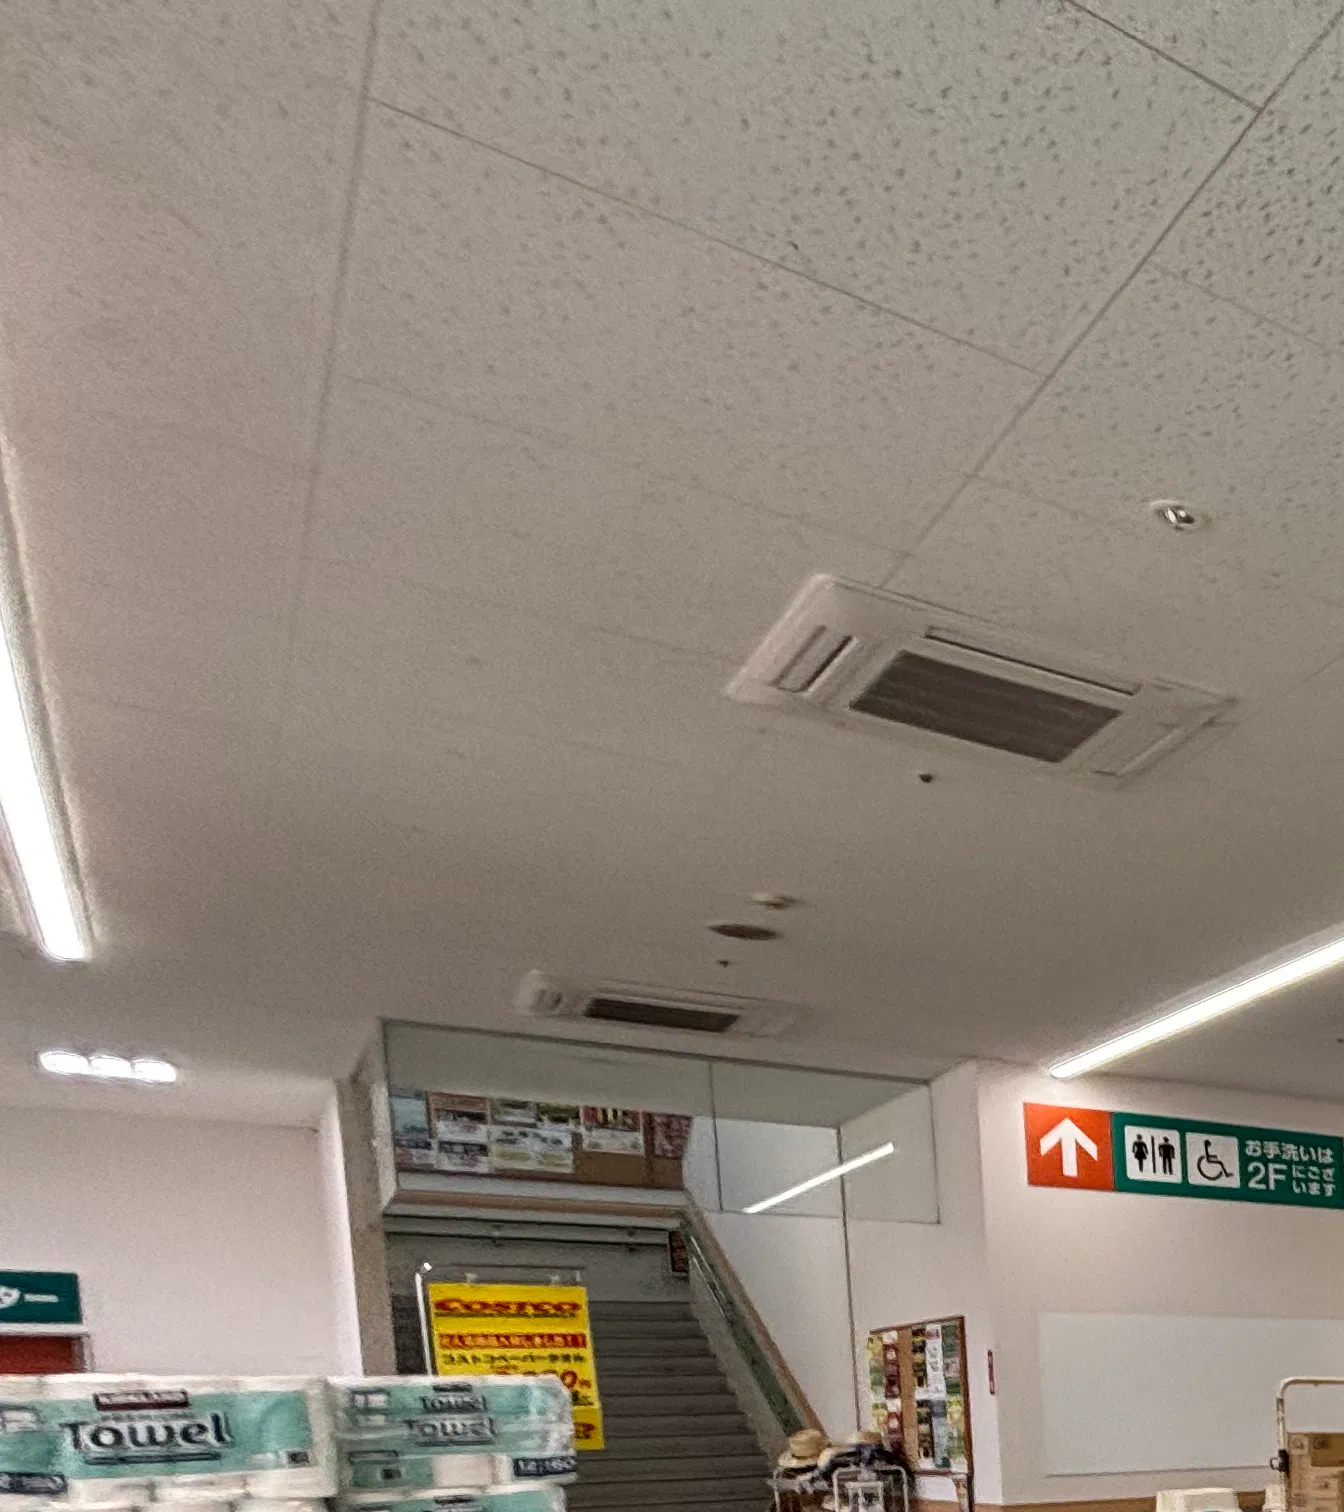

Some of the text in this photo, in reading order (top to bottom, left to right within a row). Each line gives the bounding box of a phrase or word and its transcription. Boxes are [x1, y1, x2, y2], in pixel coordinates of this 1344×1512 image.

[1245, 1139, 1334, 1165] お手洗いは
[1247, 1161, 1288, 1191] 2F
[1292, 1180, 1336, 1198] います
[58, 1411, 235, 1452] Towel
